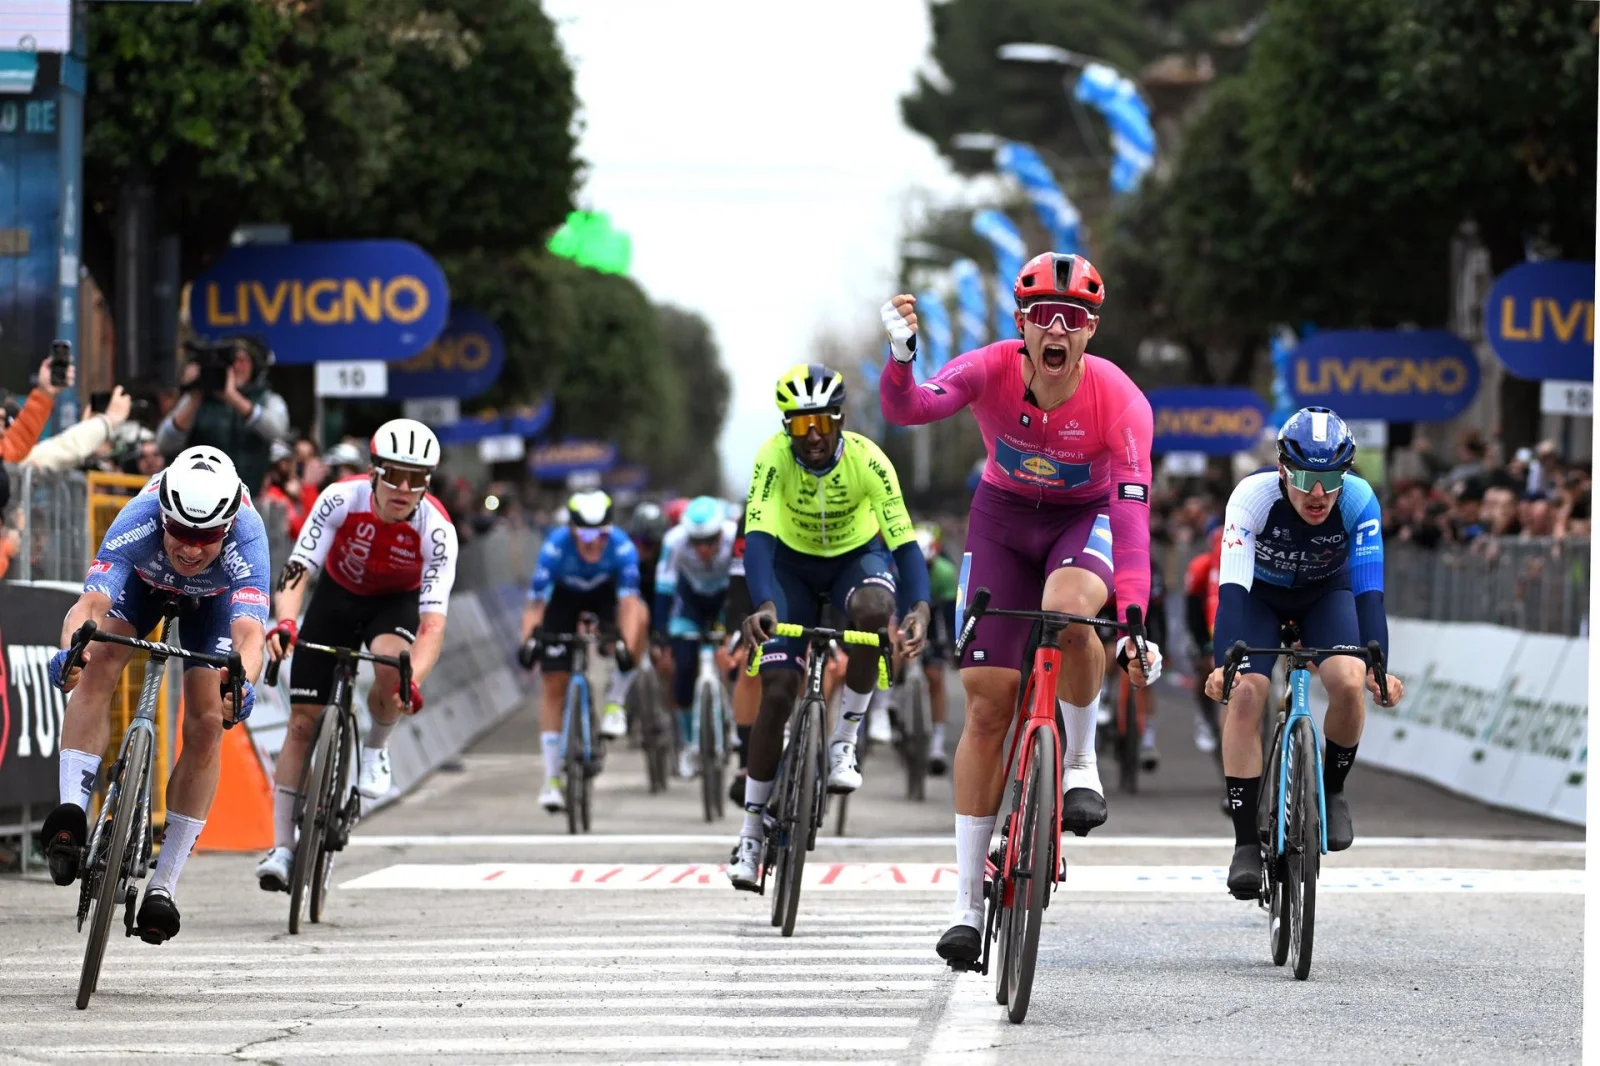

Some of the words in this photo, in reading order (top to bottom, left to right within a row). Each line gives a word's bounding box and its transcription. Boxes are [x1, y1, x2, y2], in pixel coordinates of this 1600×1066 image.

[206, 274, 430, 326] LIVIGNO
[1501, 296, 1595, 344] LIVI
[337, 368, 367, 390] 10
[1295, 356, 1468, 395] LIVIGNO
[1154, 406, 1263, 437] IVIGNO
[1003, 433, 1085, 460] madeinialy.gov.it
[105, 517, 158, 551] deceuninck
[300, 493, 345, 552] Cofidis
[222, 541, 254, 580] Alpecin
[420, 527, 449, 596] Cofidis
[1254, 540, 1309, 562] SRAEL
[130, 637, 192, 657] CANYON
